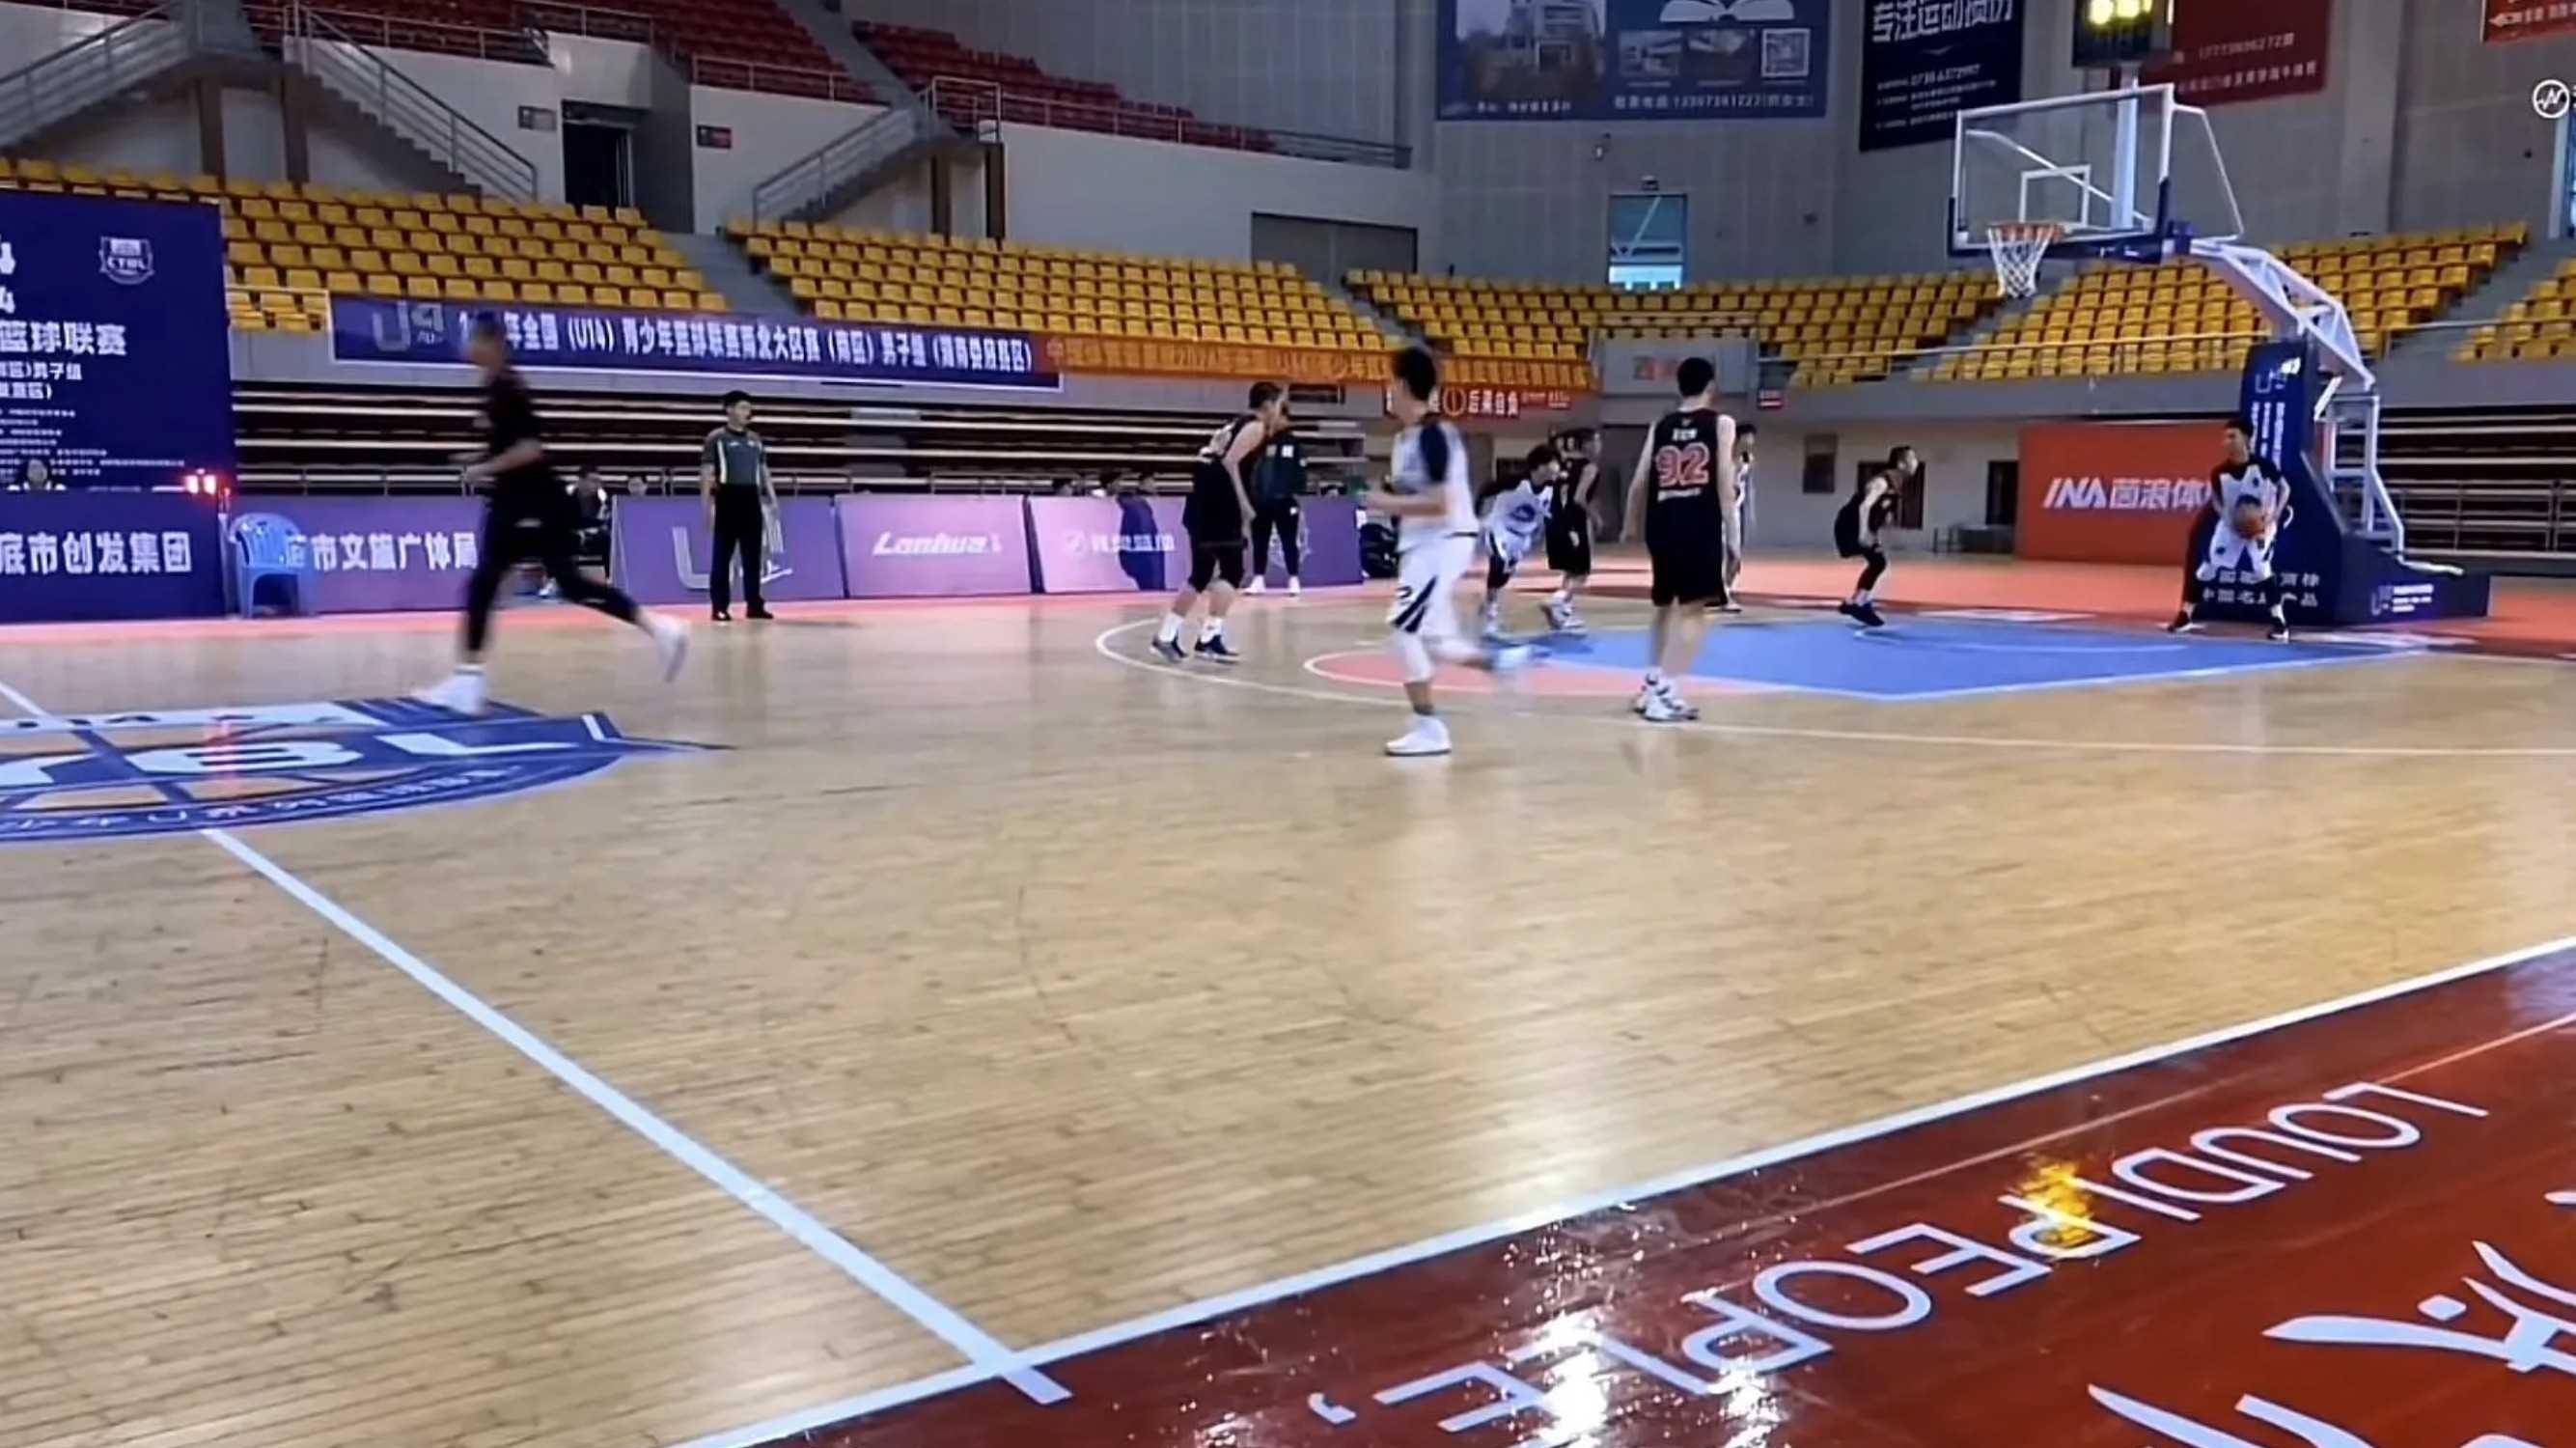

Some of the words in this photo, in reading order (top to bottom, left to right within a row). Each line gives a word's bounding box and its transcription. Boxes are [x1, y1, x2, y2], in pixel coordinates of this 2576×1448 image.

[1656, 442, 1710, 487] 92
[2043, 477, 2107, 509] INA
[2070, 1081, 2489, 1220] LOUDI
